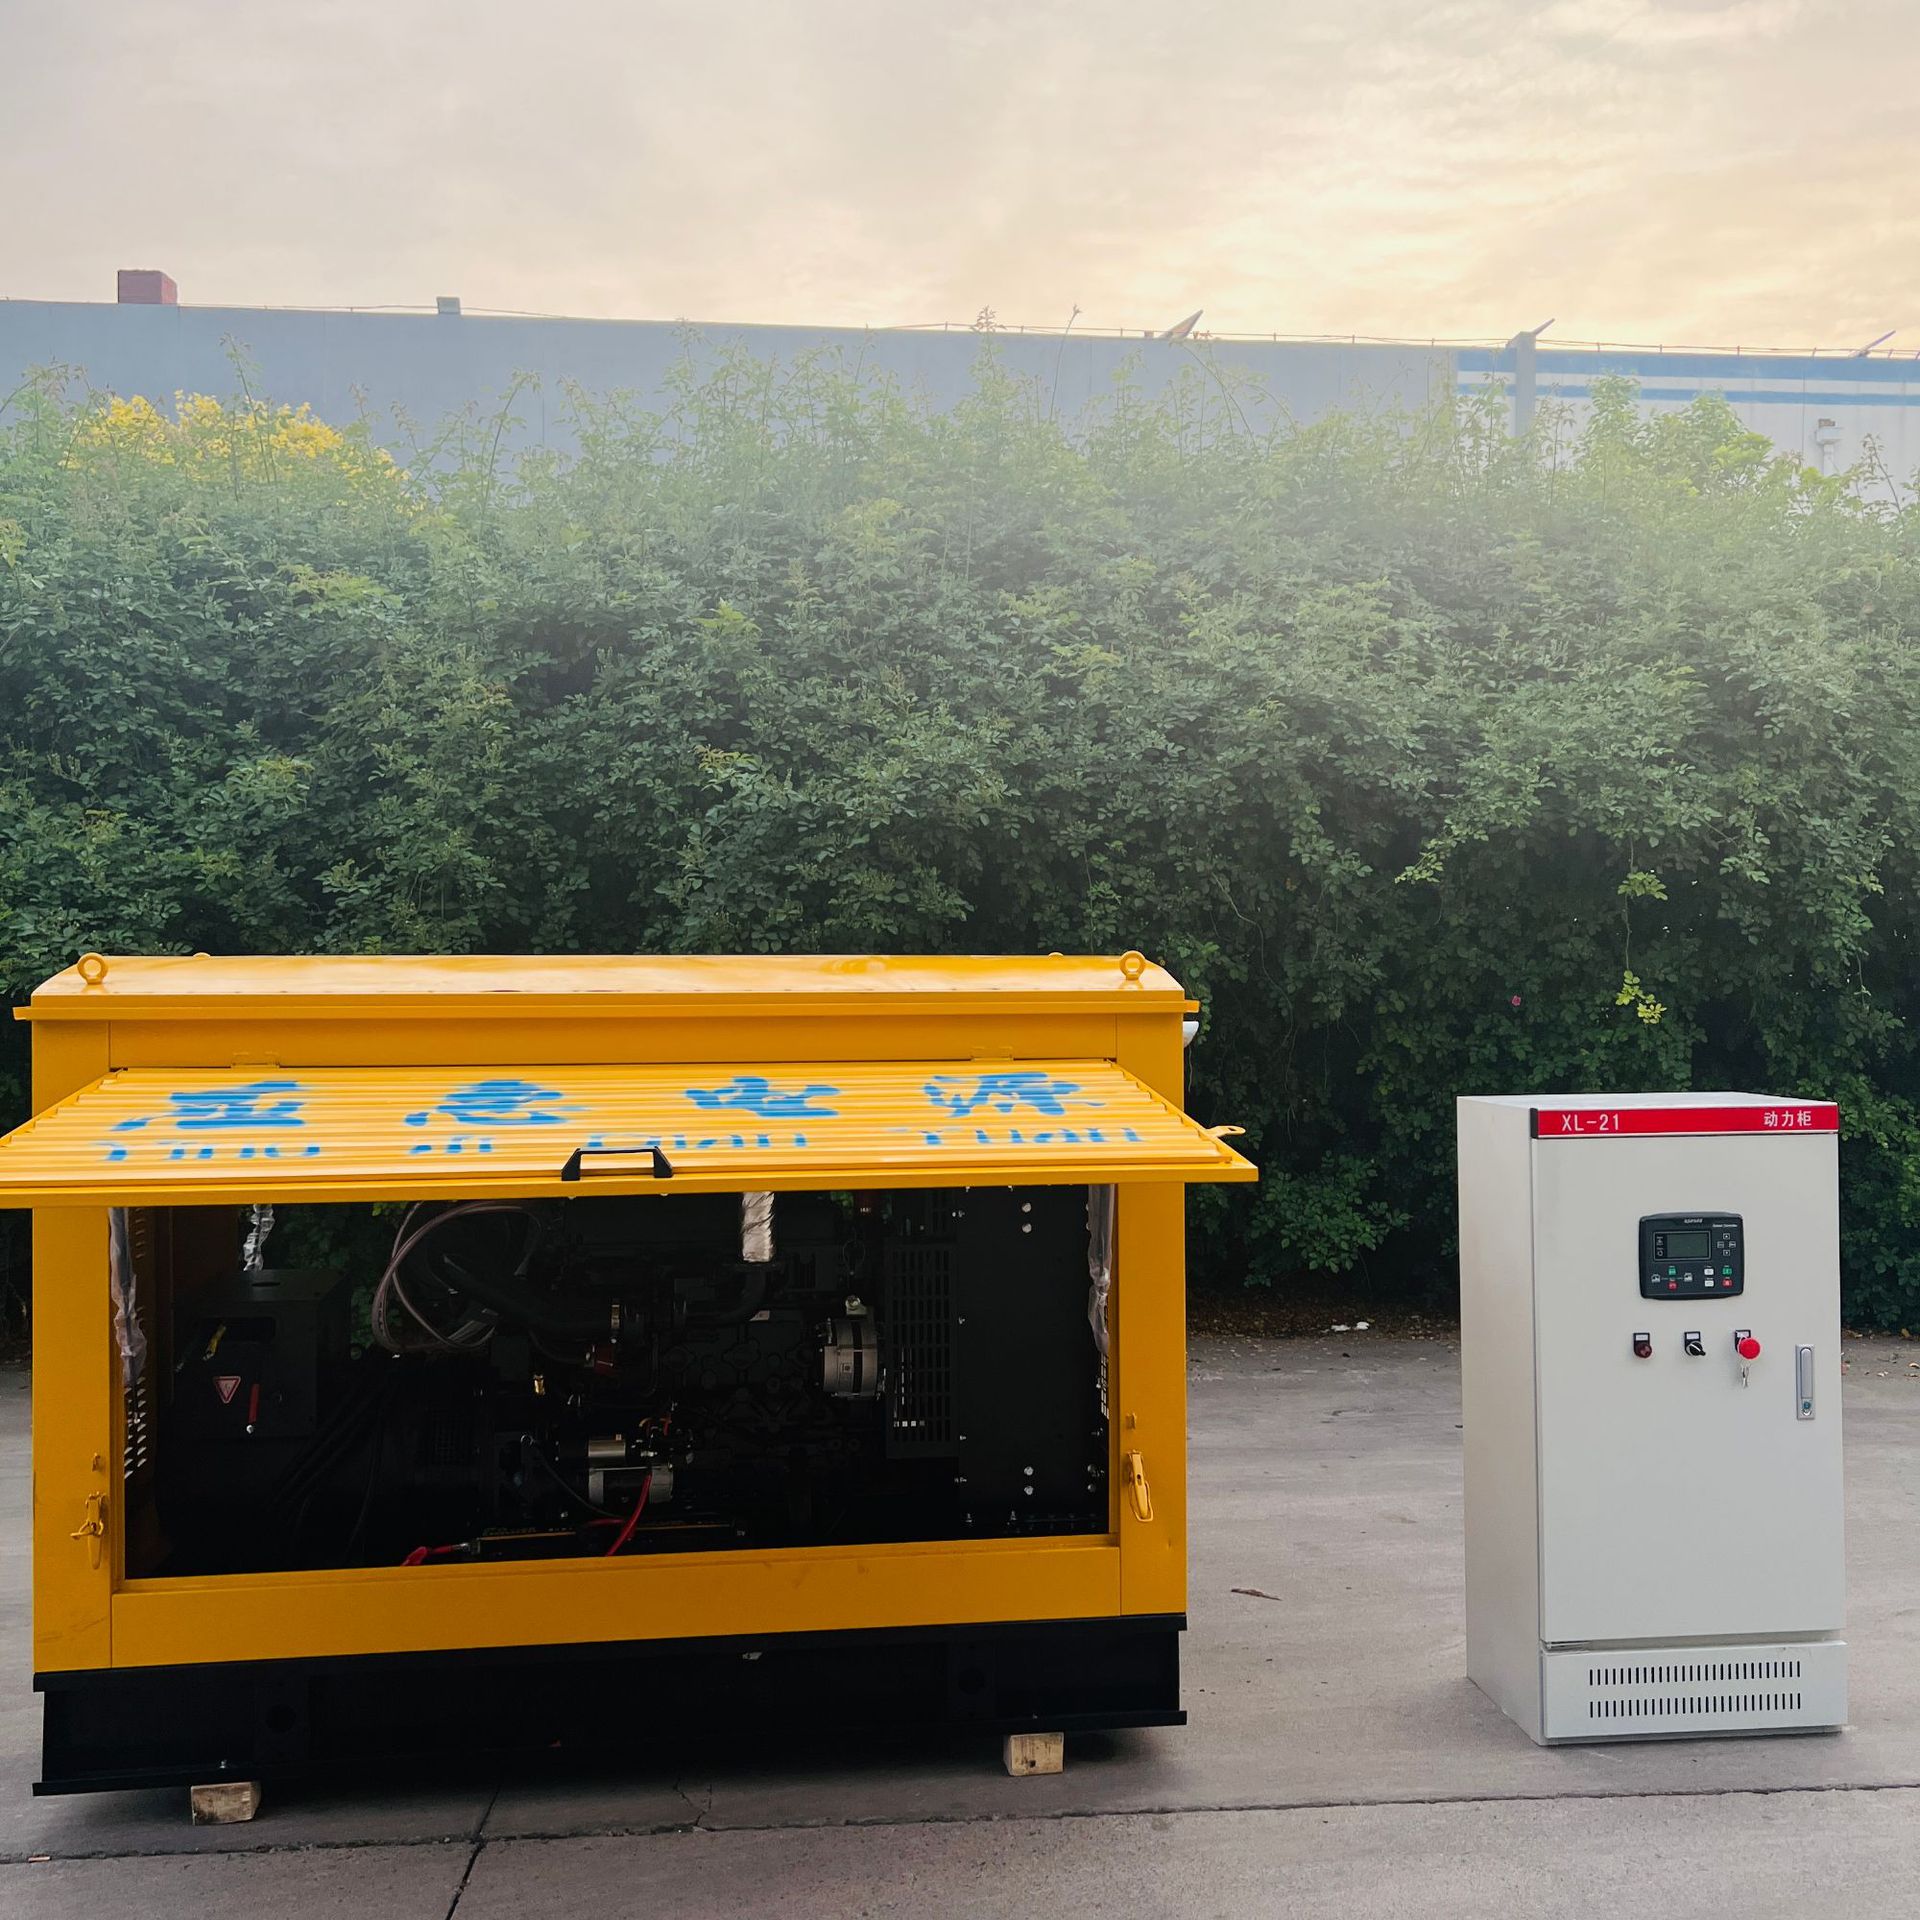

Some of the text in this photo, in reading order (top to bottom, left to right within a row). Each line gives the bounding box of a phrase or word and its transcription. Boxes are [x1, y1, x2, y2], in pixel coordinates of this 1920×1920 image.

[1561, 1113, 1620, 1132] XL-21
[1763, 1110, 1813, 1128] 动力柜
